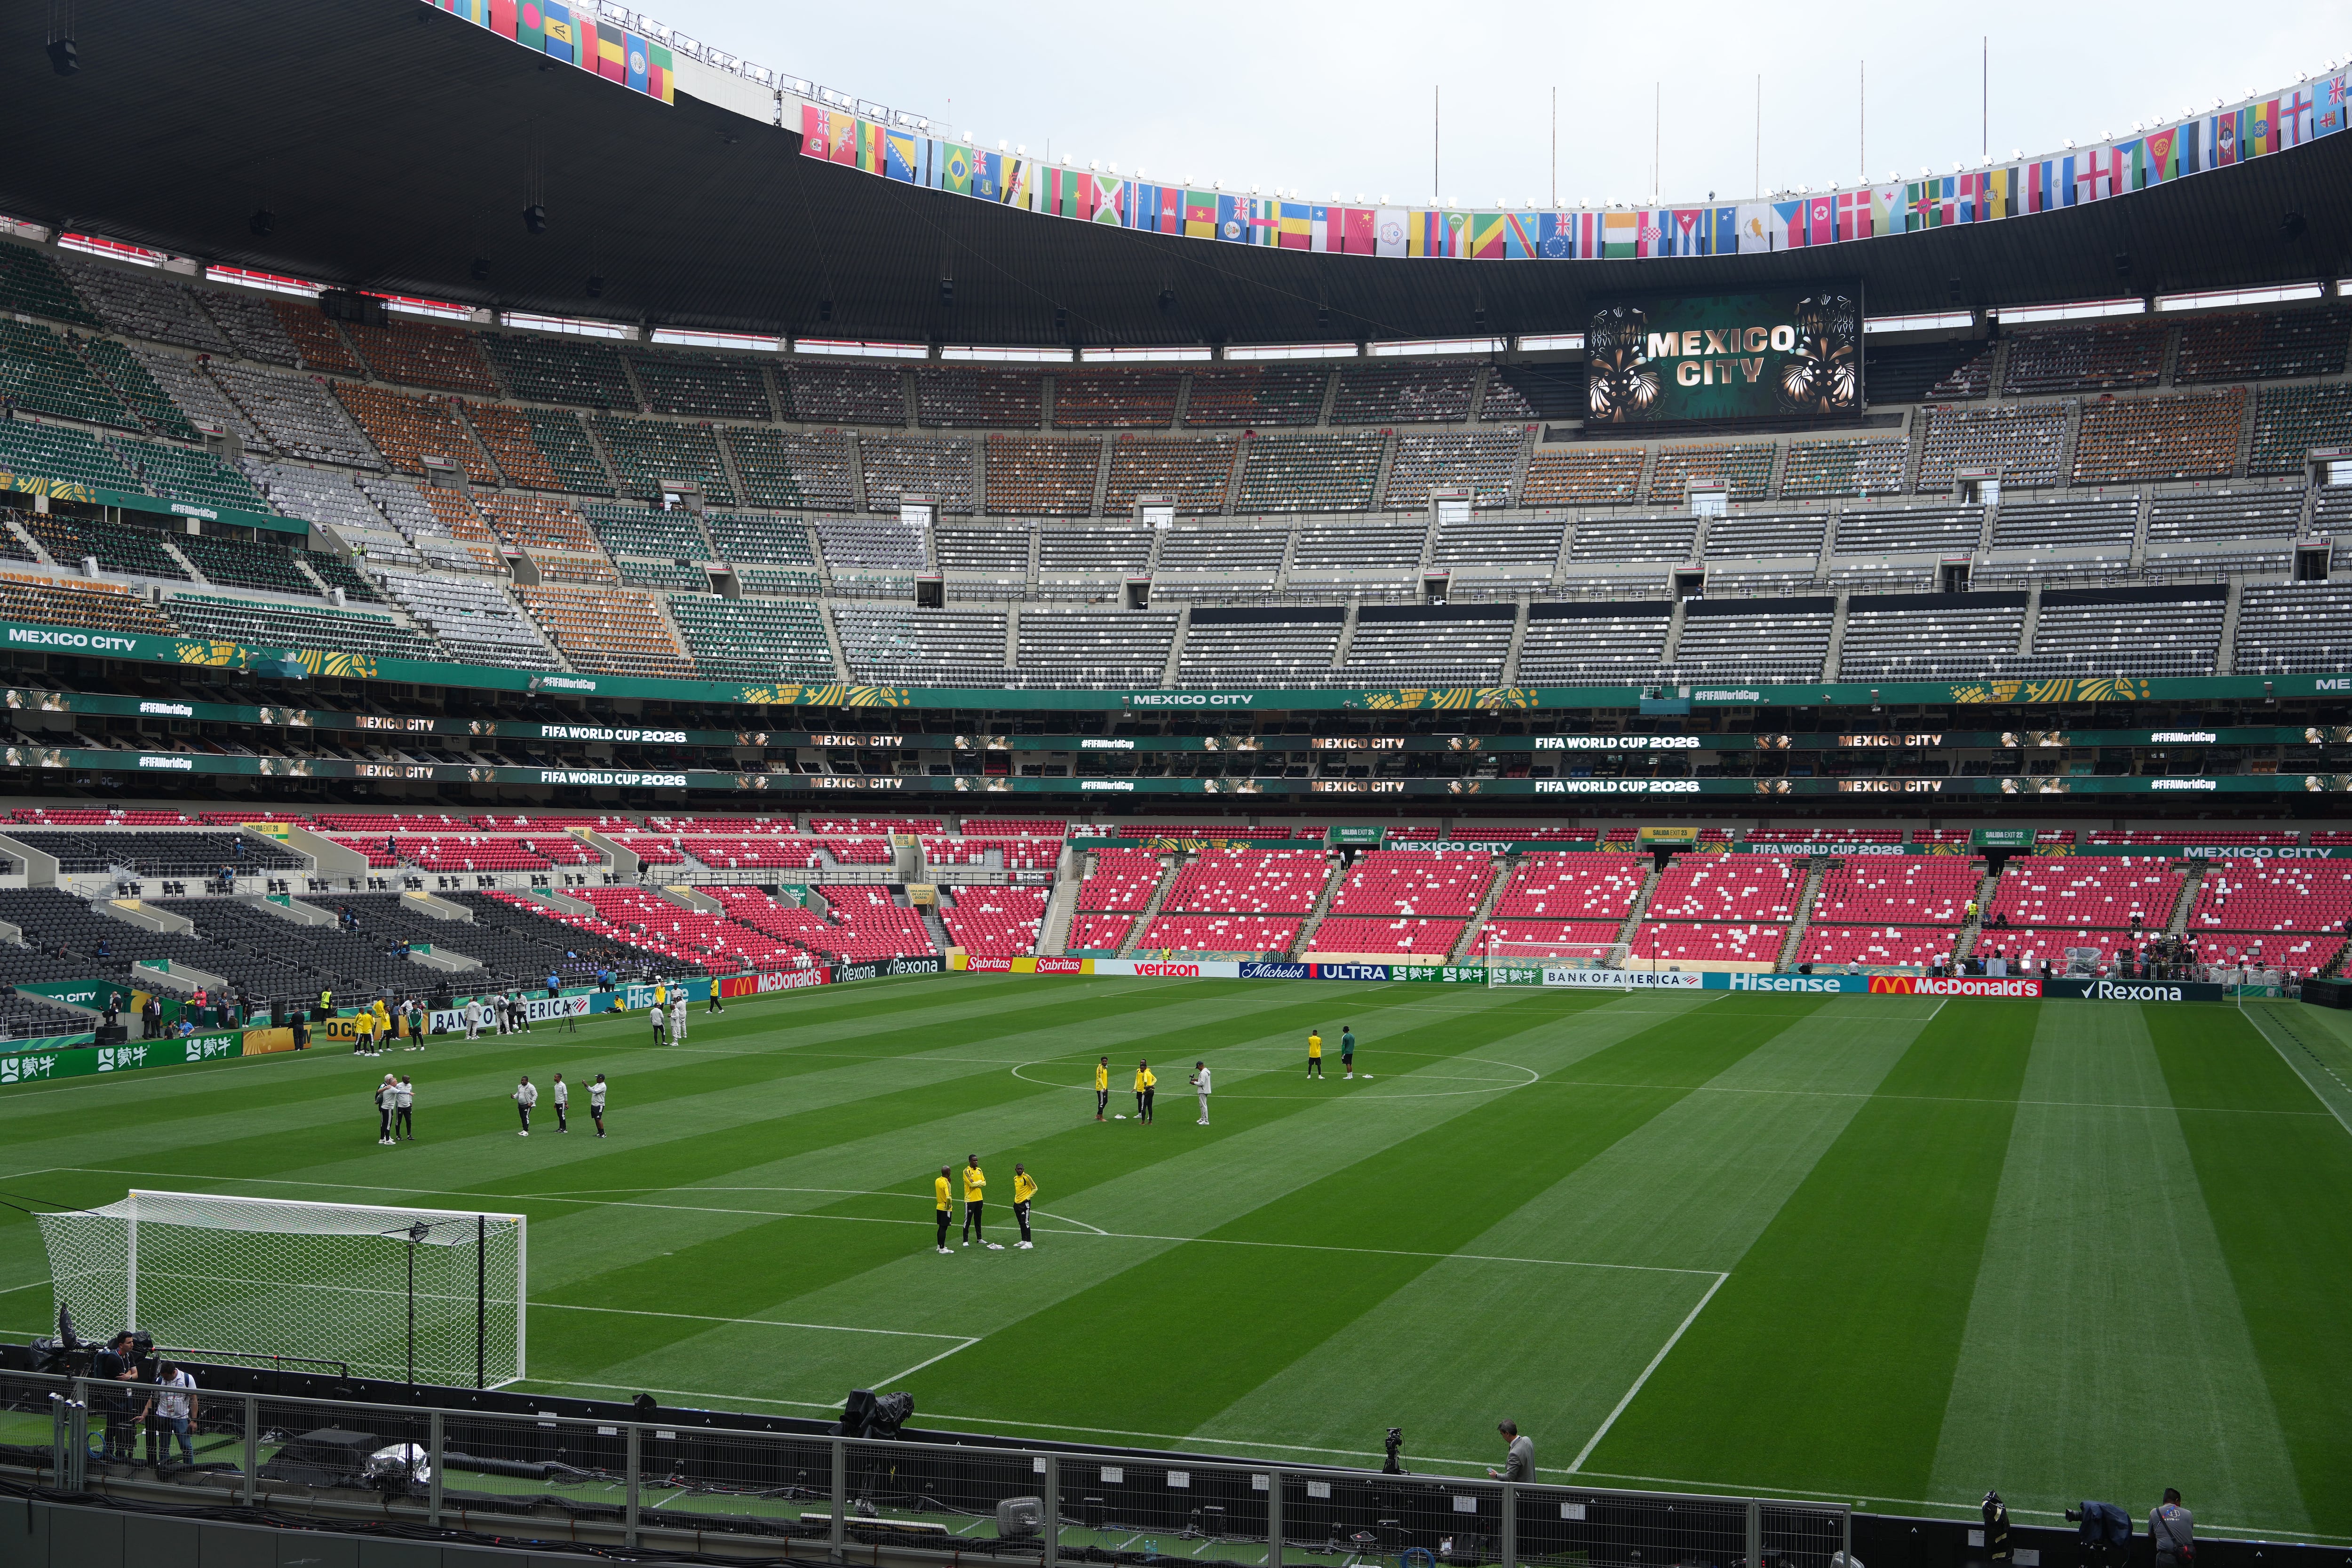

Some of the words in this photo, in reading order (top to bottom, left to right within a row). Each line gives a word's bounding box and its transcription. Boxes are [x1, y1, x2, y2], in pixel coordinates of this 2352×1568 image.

[1647, 325, 1796, 358] MEXICO
[1677, 357, 1764, 384] CITY
[171, 503, 217, 520] #FIFAWorldCup
[9, 629, 88, 647] MEXICO
[91, 636, 136, 651] CITY
[543, 677, 596, 691] #FIFAWorldCup
[2316, 678, 2352, 690] ME
[1134, 695, 1206, 704] MEXICO
[1210, 695, 1254, 704] CITY
[1695, 690, 1759, 701] #FIFAWorldCup
[140, 702, 192, 717] #FIFAWorldCup
[356, 716, 404, 730] MEXICO
[407, 718, 434, 731] CITY
[542, 725, 567, 739] FIFA
[569, 727, 613, 740] WORLD
[615, 729, 640, 741] CUP
[642, 731, 686, 742] 2026
[810, 735, 866, 746] MEXICO
[870, 735, 903, 746] CITY
[1838, 735, 1900, 746] MEXICO
[1905, 734, 1942, 746] CITY
[2151, 732, 2217, 743] #FIFAWorldCup
[1081, 739, 1134, 749] #FIFAWorldCup
[1311, 738, 1368, 748] MEXICO
[1371, 738, 1405, 748] CITY
[1535, 738, 1565, 748] FIFA
[1566, 737, 1618, 748] WORLD
[1619, 737, 1648, 748] CUP
[1649, 736, 1699, 748] 2026
[139, 756, 192, 770] #FIFAWorldCup
[355, 764, 403, 777] MEXICO
[405, 766, 434, 779] CITY
[541, 771, 567, 783] FIFA
[569, 772, 612, 785] WORLD
[615, 773, 640, 785] CUP
[642, 774, 686, 786] 2026
[810, 778, 866, 788] MEXICO
[870, 778, 903, 788] CITY
[1081, 781, 1134, 791] #FIFAWorldCup
[1311, 781, 1368, 792] MEXICO
[1371, 781, 1405, 792] CITY
[1535, 781, 1565, 792] FIFA
[1566, 781, 1618, 792] WORLD
[1619, 780, 1648, 792] CUP
[1649, 780, 1699, 792] 2026
[1838, 781, 1900, 792] MEXICO
[1905, 780, 1942, 792] CITY
[2151, 780, 2217, 791] #FIFAWorldCup
[1391, 842, 1465, 852] MEXICO
[1469, 843, 1513, 852] CITY
[1752, 844, 1779, 854] FIFA
[1781, 844, 1828, 854] WORLD
[1830, 845, 1856, 854] CUP
[1859, 845, 1904, 855] 2026
[2184, 847, 2273, 857] MEXICO
[2278, 848, 2333, 858] CITY
[893, 958, 938, 975] Rexona
[968, 957, 1010, 971] Sabritas
[1036, 959, 1080, 972] Sabritas
[1134, 961, 1199, 977] verizon
[1242, 963, 1305, 978] Michelob
[1324, 965, 1386, 979] ULTRA
[842, 964, 876, 982] Rexona
[1409, 967, 1436, 981] 蒙牛
[1459, 968, 1486, 982] 蒙牛
[1510, 970, 1536, 983] 蒙牛
[1548, 972, 1587, 982] BANK
[1592, 973, 1609, 983] OF
[1613, 974, 1680, 985] AMERICA
[757, 969, 822, 993] McDonald's
[1729, 973, 1840, 992] Hisense
[1914, 978, 2038, 996] McDonald's
[67, 992, 96, 1003] CITY
[2098, 981, 2182, 1001] Rexona
[627, 988, 689, 1010] Hisne
[437, 1011, 467, 1029] BAN
[530, 999, 569, 1019] ERICA
[204, 1036, 231, 1058] 蒙牛
[118, 1046, 148, 1068] 蒙牛
[22, 1055, 56, 1079] 蒙牛
